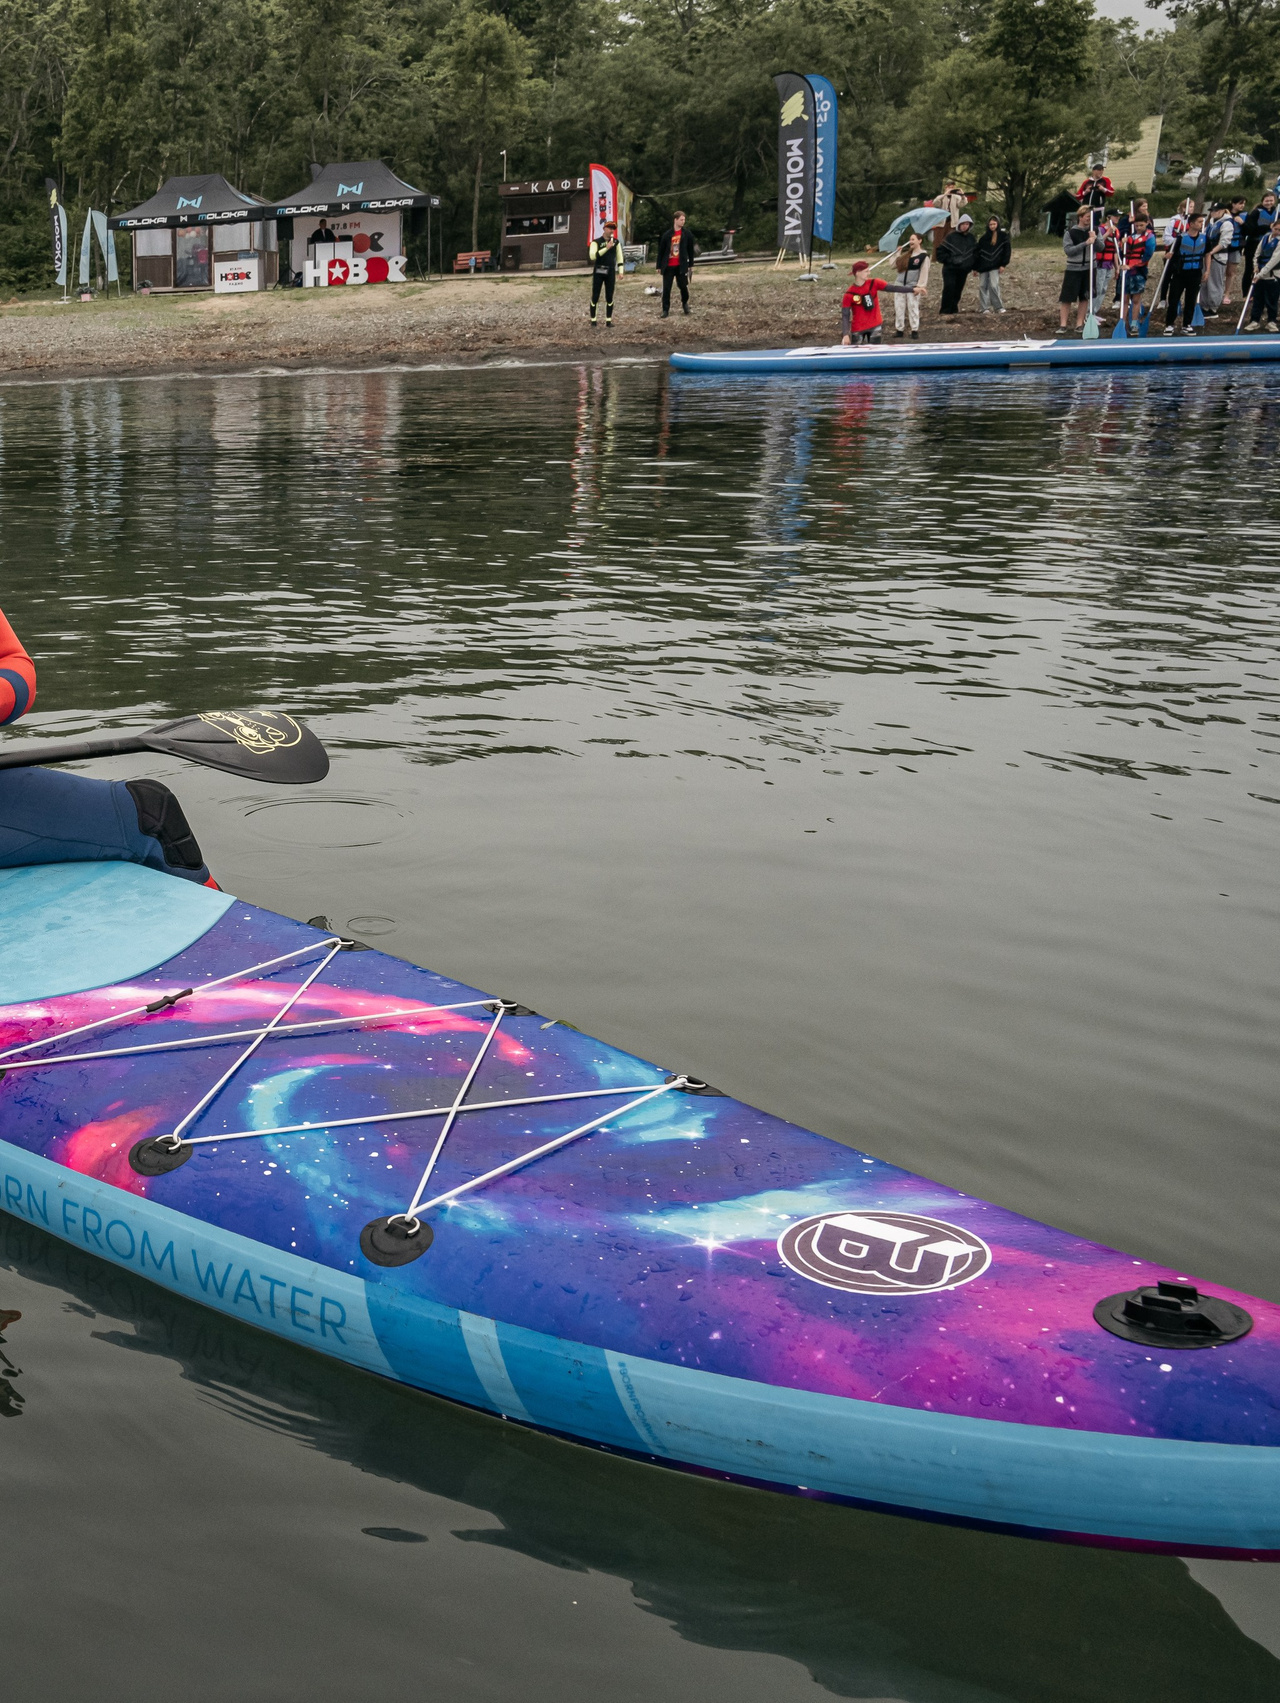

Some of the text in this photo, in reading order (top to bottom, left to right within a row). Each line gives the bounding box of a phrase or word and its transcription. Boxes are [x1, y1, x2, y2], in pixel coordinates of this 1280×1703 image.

[531, 178, 584, 193] КАФЕ
[784, 137, 804, 236] MOLOKAI
[349, 222, 361, 230] FM
[62, 1197, 179, 1281] FROM
[191, 1248, 348, 1345] WATER
